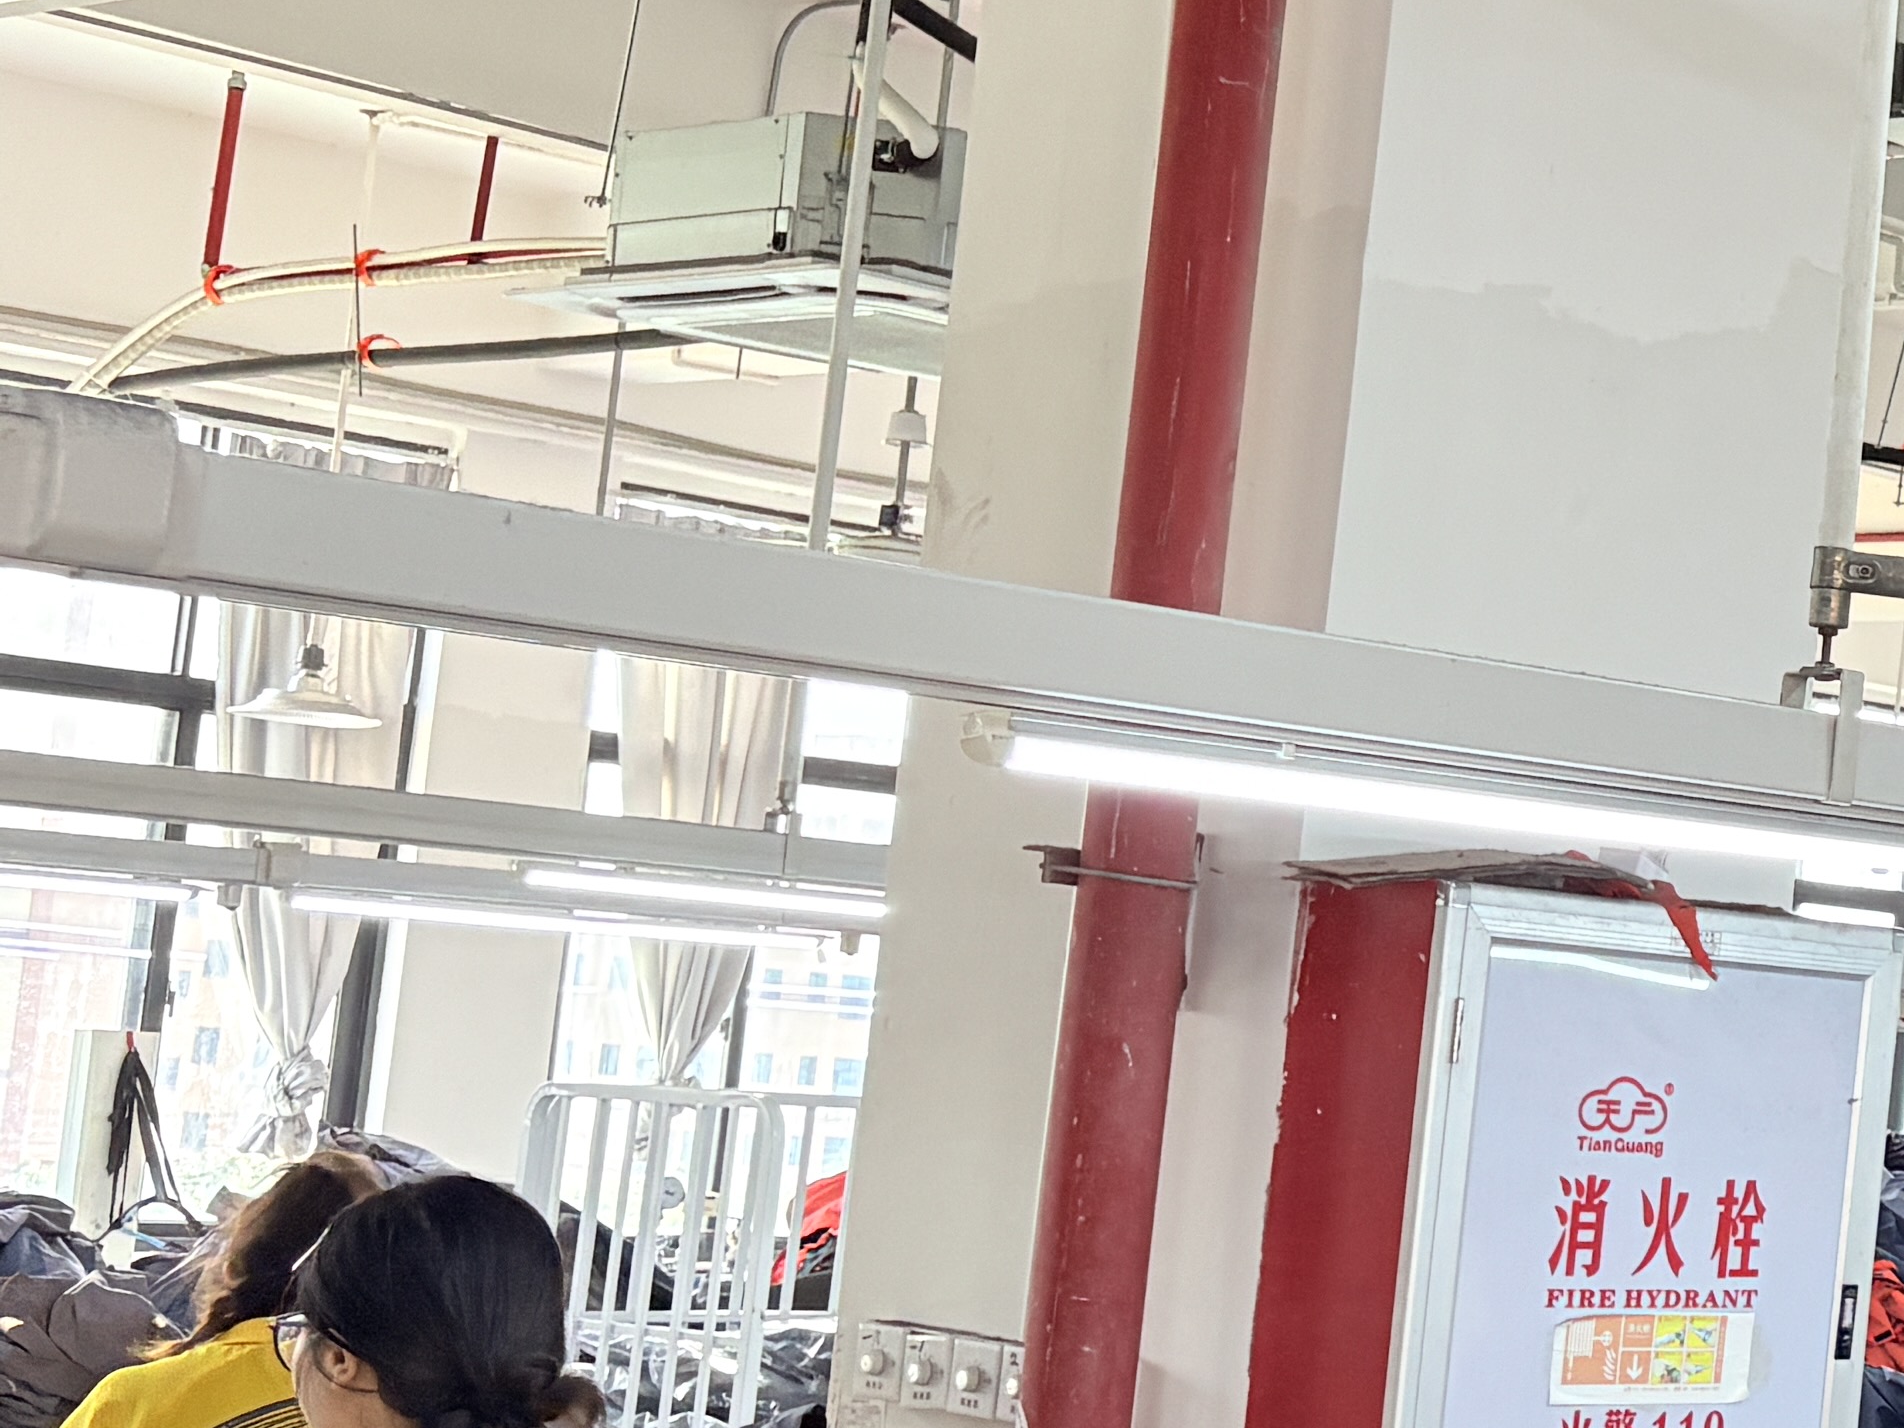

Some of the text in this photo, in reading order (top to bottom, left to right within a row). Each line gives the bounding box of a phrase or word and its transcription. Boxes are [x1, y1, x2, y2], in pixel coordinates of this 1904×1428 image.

[1548, 1174, 1767, 1279] 消火栓
[1545, 1288, 1758, 1308] FIRE HYDRANT
